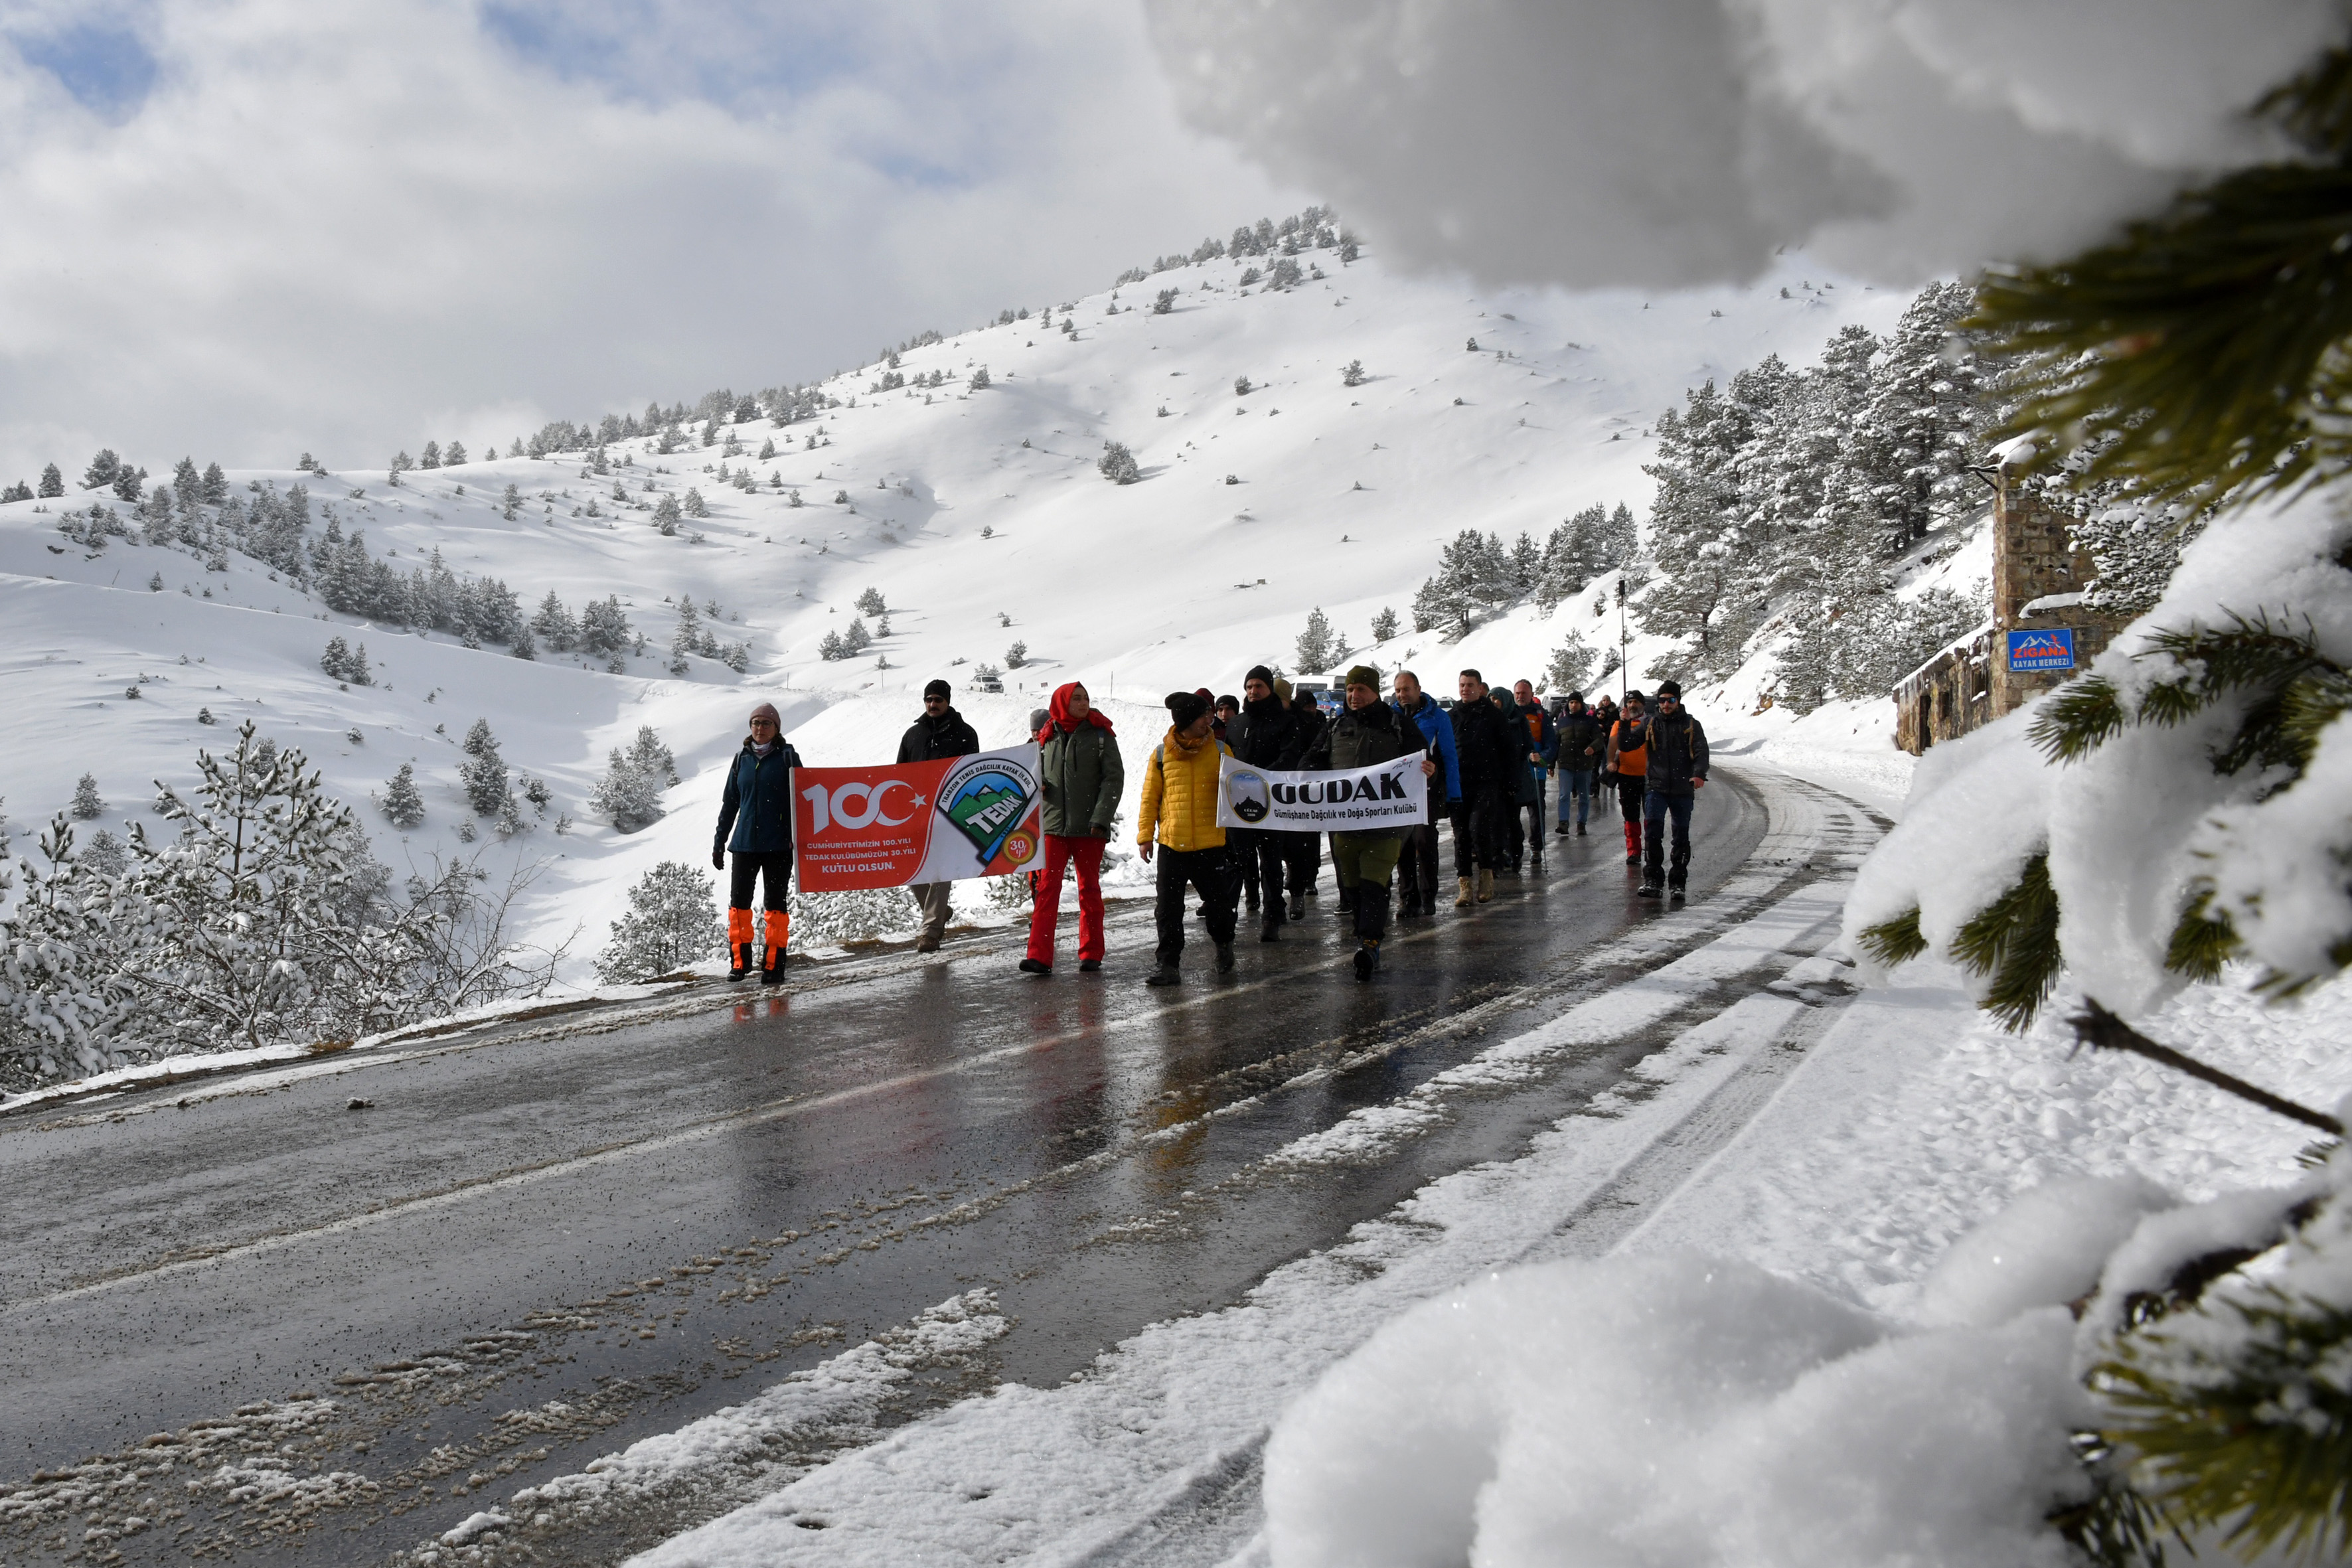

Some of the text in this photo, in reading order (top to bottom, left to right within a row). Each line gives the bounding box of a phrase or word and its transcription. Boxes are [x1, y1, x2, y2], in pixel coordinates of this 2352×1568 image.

[941, 781, 960, 803] TRABZON
[960, 769, 975, 781] TENİS
[975, 763, 1001, 773] DAĞCILIK
[1002, 765, 1020, 775] KAYAK
[1271, 771, 1407, 805] GÜDAK
[965, 795, 1023, 834] TEDAK
[1274, 809, 1310, 821] Gümüşhane
[1311, 809, 1337, 821] Dağcılık
[1347, 807, 1364, 819] Doğa
[1365, 806, 1392, 819] Sporları
[1393, 803, 1417, 815] Kulübü
[807, 840, 880, 849] CUMHURİYETİMİZİN
[1010, 840, 1025, 850] 30
[830, 850, 888, 860] KULÜBÜMÜZÜN
[822, 862, 896, 873] KUTLU OLSUN.
